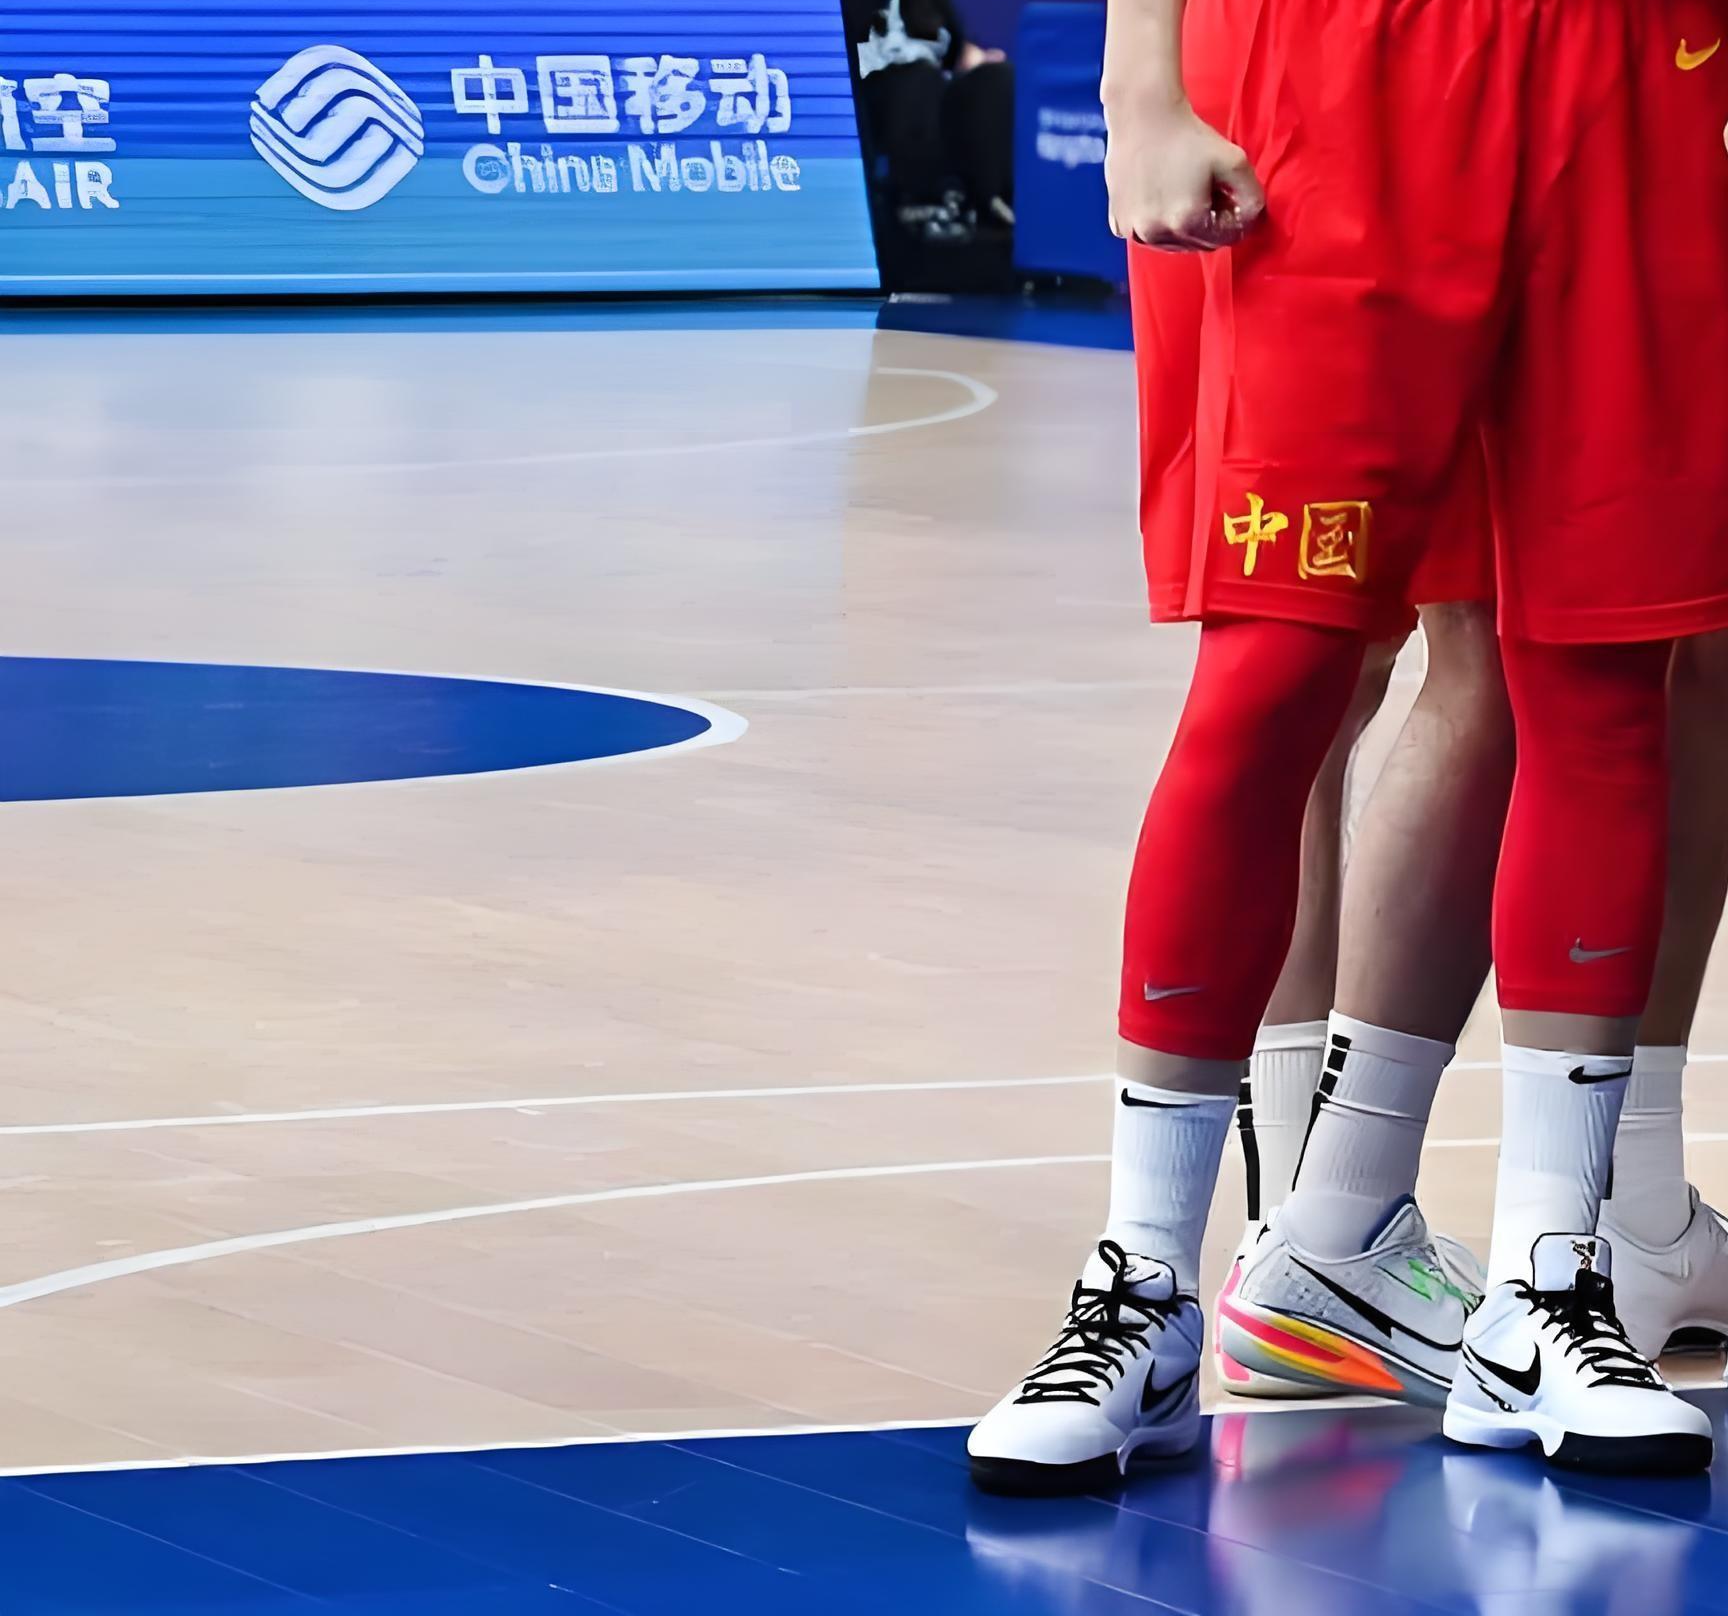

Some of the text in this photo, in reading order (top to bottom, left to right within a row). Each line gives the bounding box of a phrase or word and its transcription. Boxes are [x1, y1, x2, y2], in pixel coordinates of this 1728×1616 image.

[0, 73, 117, 152] 空
[450, 54, 792, 134] 中国移动
[463, 139, 801, 194] China Mobile
[1223, 492, 1372, 583] 中国
